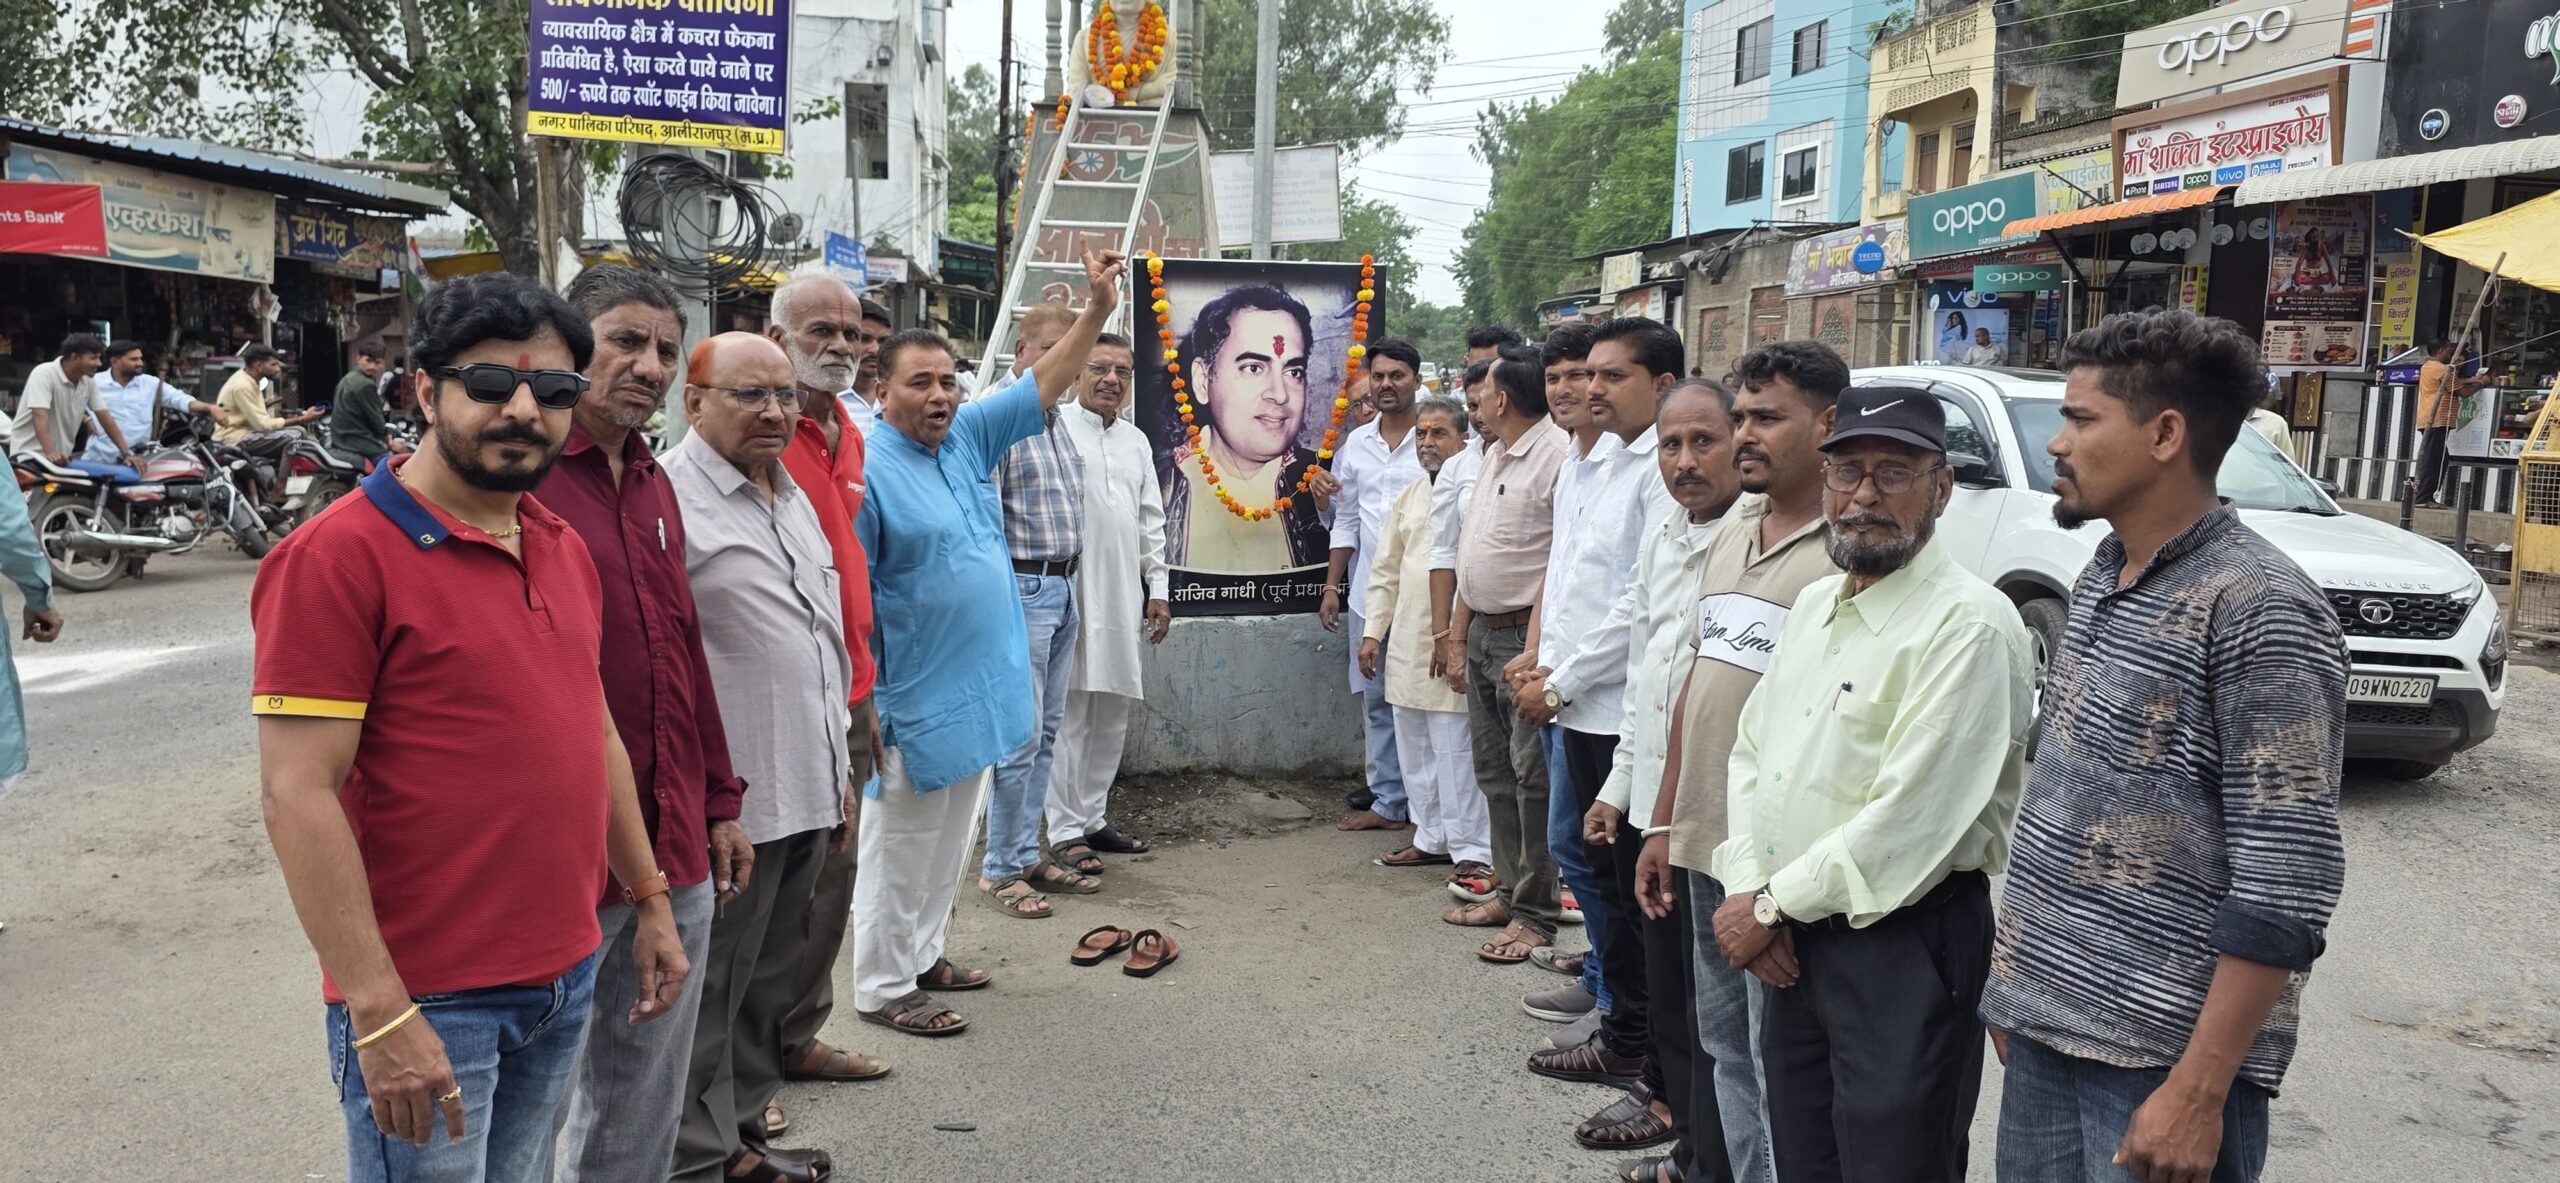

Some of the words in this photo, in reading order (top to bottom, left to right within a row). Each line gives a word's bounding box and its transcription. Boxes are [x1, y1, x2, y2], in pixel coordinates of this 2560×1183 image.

[542, 17, 627, 41] व्यावसायिक
[661, 20, 675, 44] में
[678, 28, 720, 47] कचरा
[724, 23, 776, 50] फेकना
[2158, 5, 2295, 75] oppo
[540, 44, 602, 71] प्रतिबंधित
[603, 47, 618, 75] है,
[623, 48, 651, 76] ऐसा
[654, 51, 686, 76] करते
[689, 52, 717, 78] पाये
[720, 55, 751, 80] जाने
[755, 63, 774, 82] पर
[540, 77, 576, 104] 500/-
[579, 76, 608, 103] रूपये
[610, 85, 632, 104] तक
[633, 80, 662, 107] स्पॉट
[664, 82, 698, 113] फाईन
[701, 83, 732, 112] किया
[538, 115, 566, 129] नगर
[569, 112, 612, 133] पालिका
[661, 119, 733, 147] आलीराजपुर
[2124, 136, 2149, 176] माँ
[2149, 131, 2203, 171] शक्ति
[2154, 180, 2178, 190] SAMSUNG
[2186, 174, 2208, 186] oppo
[2218, 170, 2243, 182] vivo
[2130, 186, 2147, 196] iPhone
[0, 210, 21, 223] nts
[24, 209, 66, 224] Bank
[1933, 198, 2006, 237] oppo
[1858, 252, 1882, 260] TECNO
[1986, 271, 2050, 284] oppo
[1947, 287, 1998, 303] vio
[1220, 580, 1257, 600] गांधी
[1295, 582, 1328, 597] प्रधा
[2322, 578, 2432, 590] ARRIER
[2350, 678, 2431, 699] 09WN0220
